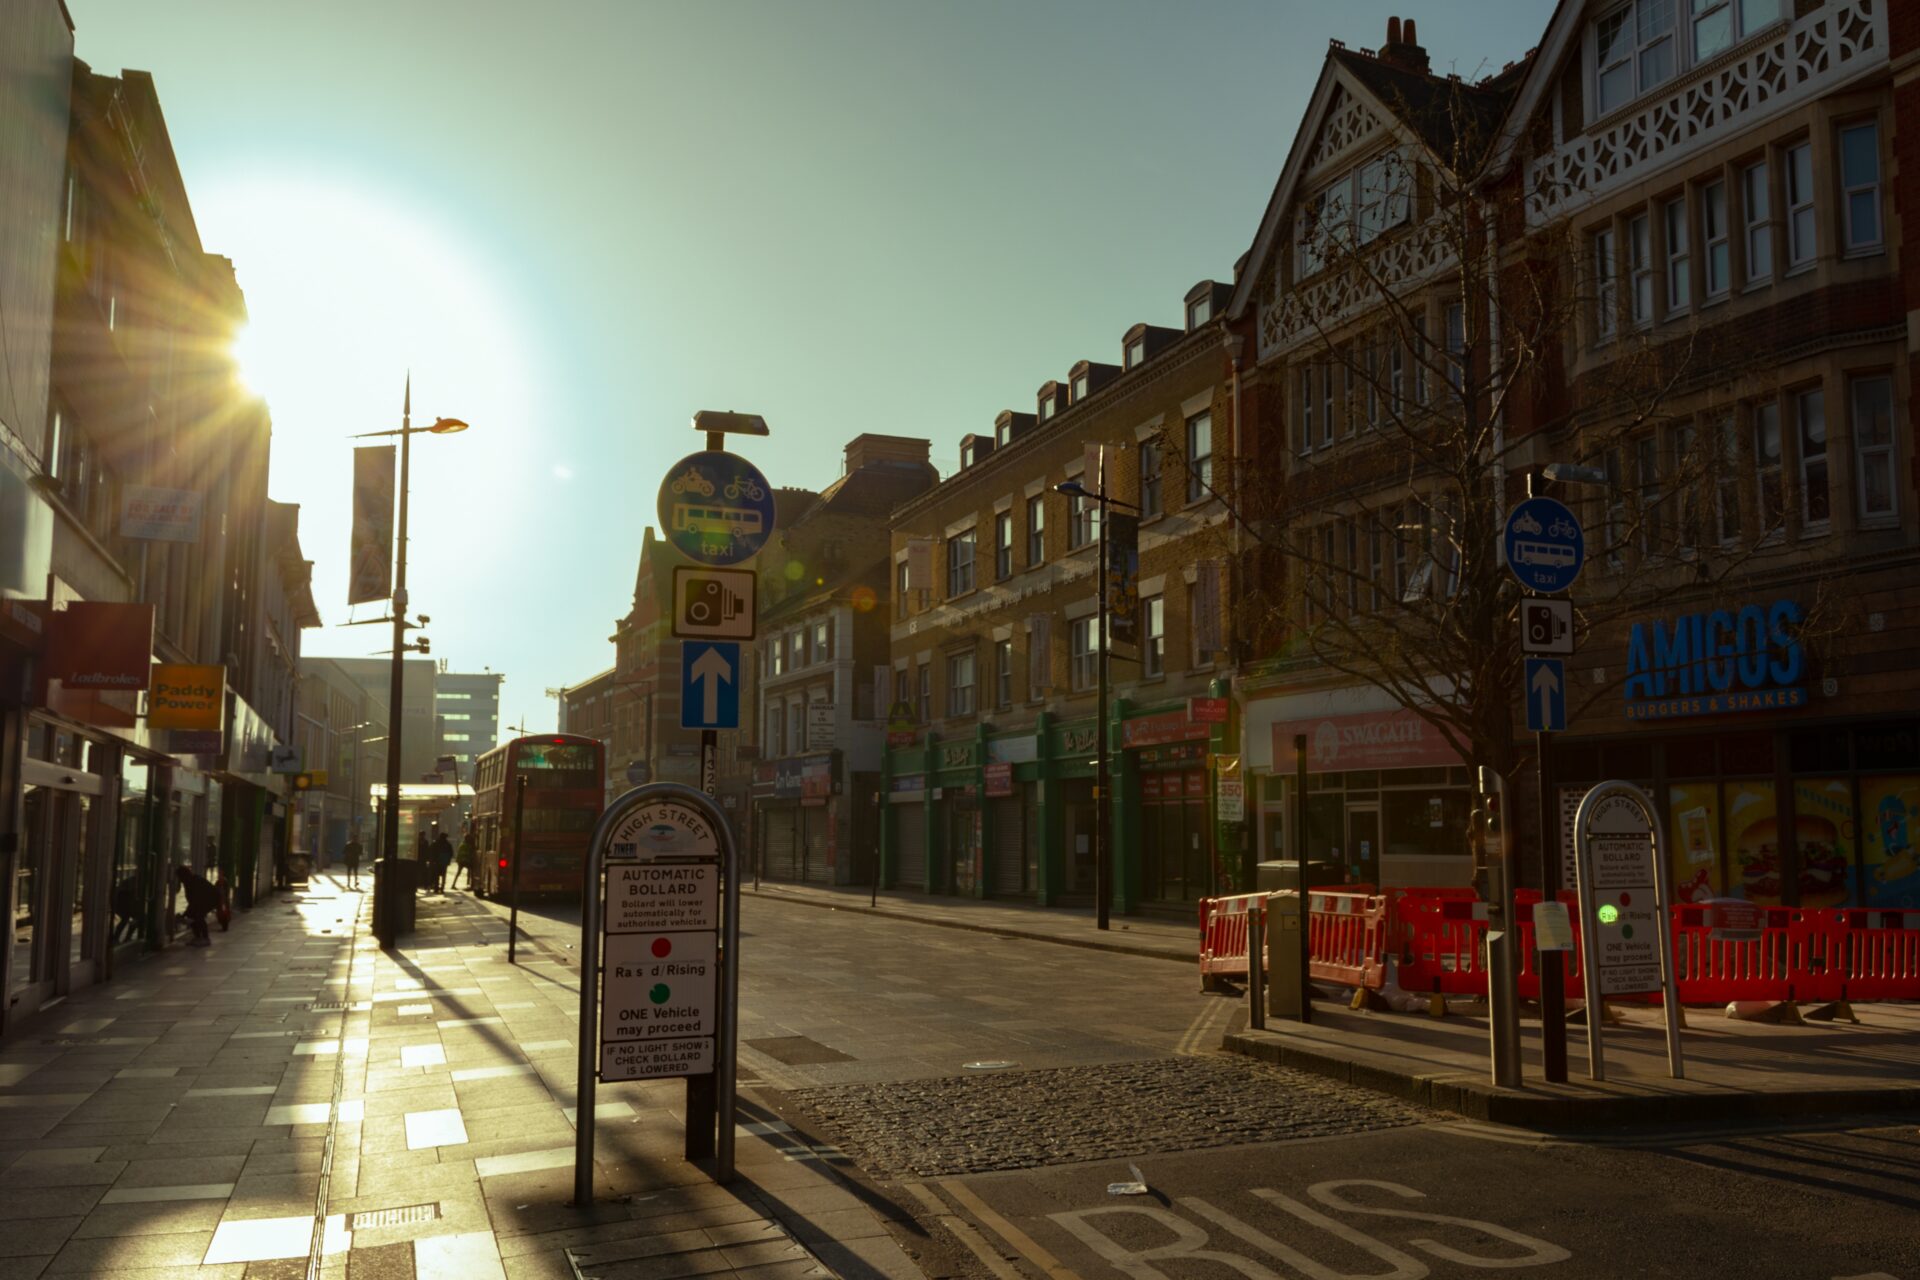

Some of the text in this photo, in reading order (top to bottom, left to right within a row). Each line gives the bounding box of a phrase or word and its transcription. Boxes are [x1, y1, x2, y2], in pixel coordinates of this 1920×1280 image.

[701, 540, 734, 557] taxi
[1534, 571, 1557, 585] taxi
[1623, 599, 1806, 699] AMIGOS
[70, 671, 142, 687] Ladbrokes
[156, 683, 216, 699] Paddy
[155, 696, 214, 710] Power
[1626, 690, 1800, 719] BURGERS & SHAKES
[1594, 798, 1644, 823] HIGH STREET
[620, 809, 710, 841] HIGH STREET
[1598, 842, 1644, 852] AUTOMATIC
[1602, 852, 1641, 862] BOLLARD
[622, 869, 705, 881] AUTOMATIC
[629, 883, 697, 896] BOLLARD
[621, 900, 656, 908] Bollard
[678, 899, 703, 907] lower
[623, 908, 701, 919] automatically for
[617, 918, 707, 929] authorised vehicles
[1606, 942, 1651, 952] ONE Vehicle
[1606, 953, 1653, 963] may proceed
[1608, 968, 1617, 976] NO
[1619, 967, 1635, 976] LIGHT
[1628, 975, 1655, 983] BOLLARD
[619, 1006, 700, 1021] ONE Vehicle
[616, 1020, 701, 1037] may proceed
[606, 1047, 616, 1056] IF
[619, 1046, 635, 1055] NO
[638, 1043, 668, 1054] LIGHT
[615, 1052, 701, 1066] CHECK BOLLARD
[626, 1063, 689, 1075] IS LOWERED
[1045, 1178, 1572, 1280] BUS
